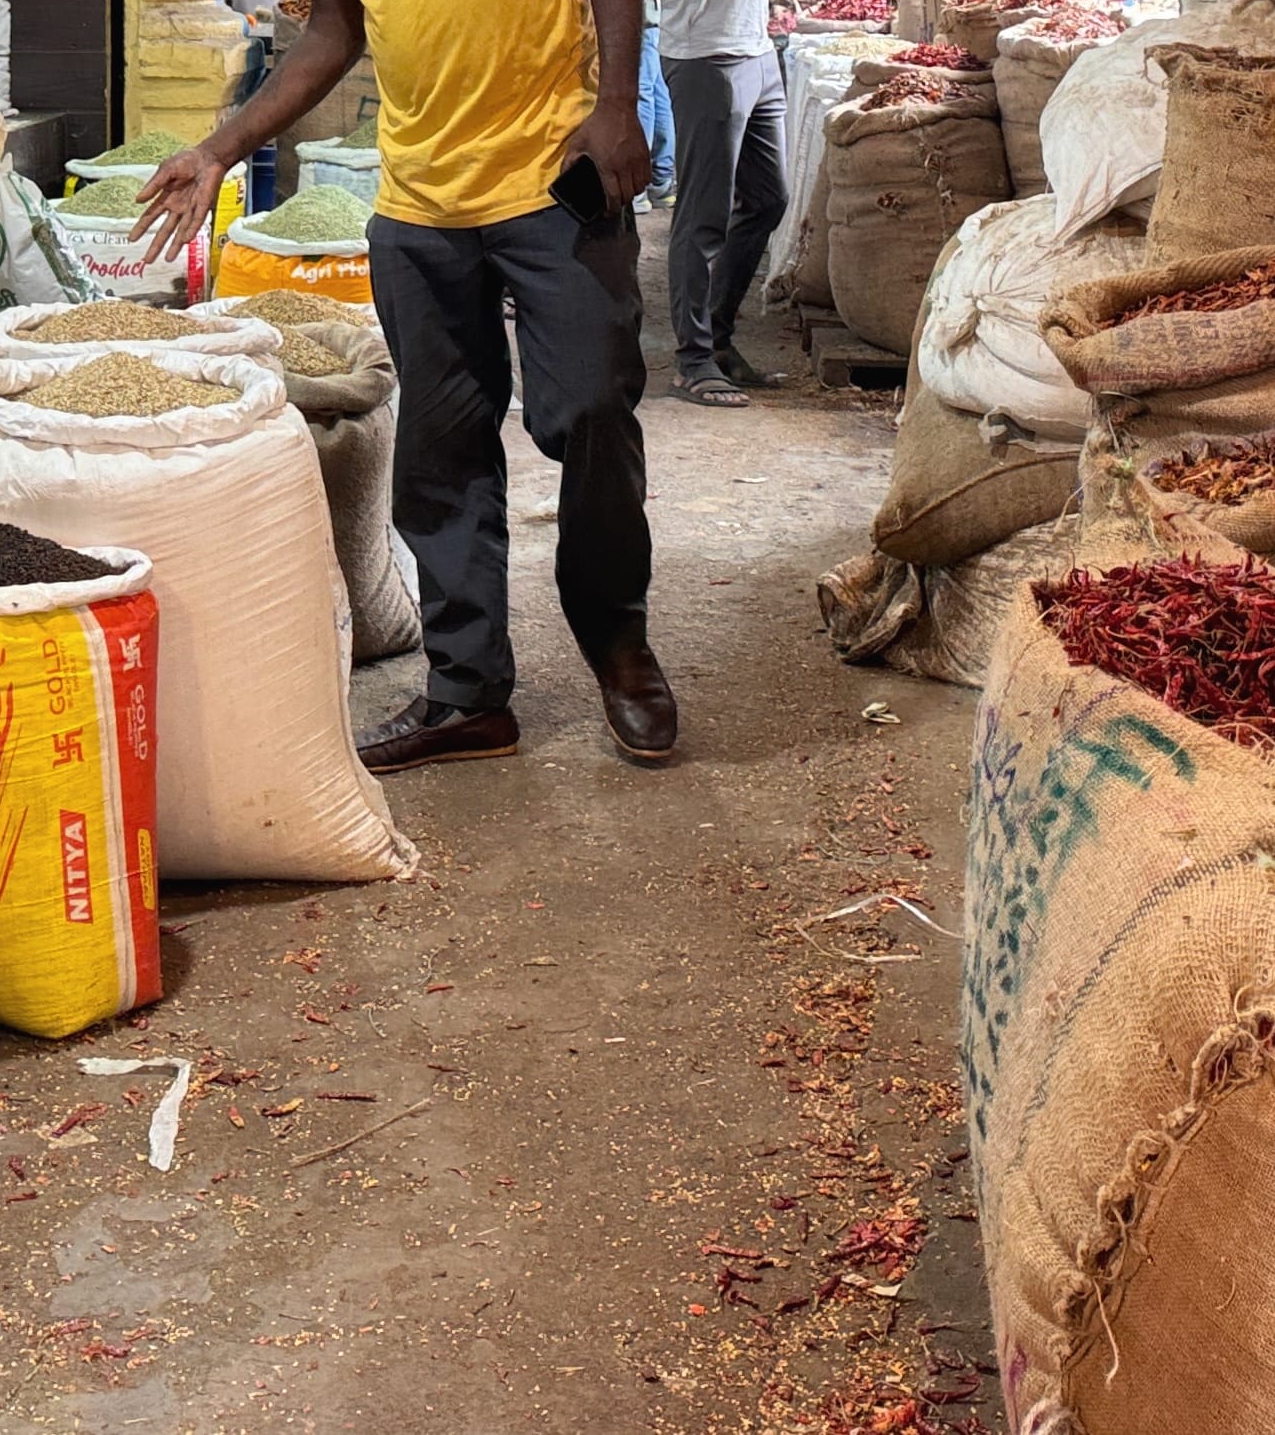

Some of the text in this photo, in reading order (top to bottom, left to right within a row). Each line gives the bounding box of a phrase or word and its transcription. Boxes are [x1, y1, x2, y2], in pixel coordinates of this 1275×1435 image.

[290, 262, 332, 285] Agri
[42, 638, 66, 716] GOLD
[133, 683, 149, 761] GOLD
[64, 820, 91, 923] NITYA
